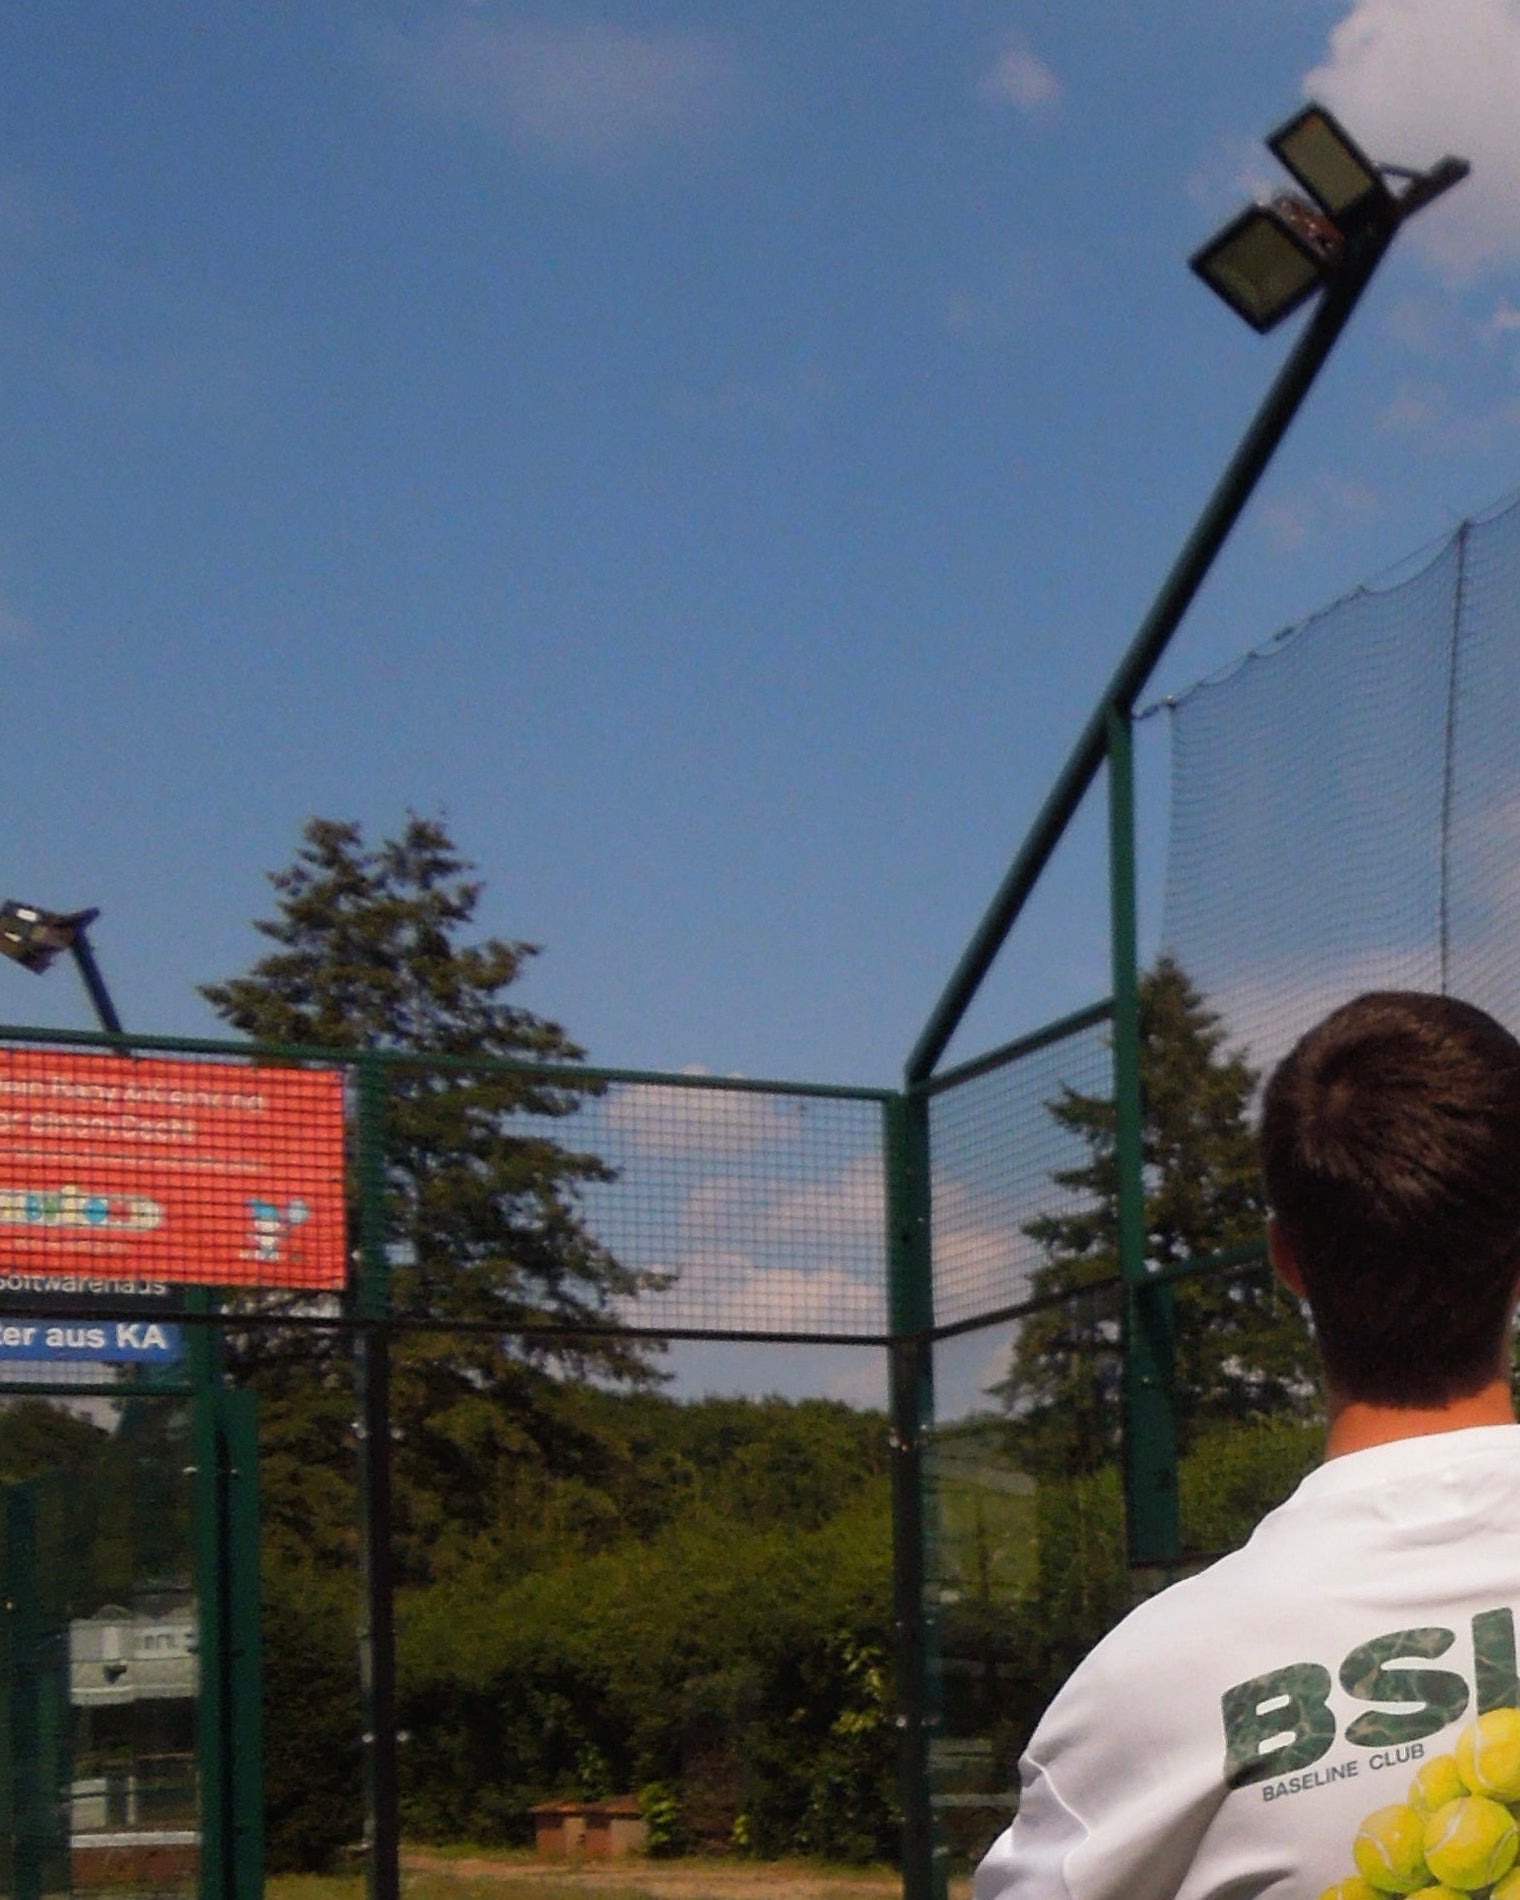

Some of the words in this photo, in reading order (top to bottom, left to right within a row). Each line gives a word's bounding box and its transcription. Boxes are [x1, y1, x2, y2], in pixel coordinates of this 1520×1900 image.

[0, 1326, 36, 1346] er
[46, 1328, 105, 1348] aus
[116, 1323, 168, 1349] KA
[1261, 1760, 1359, 1802] BASELINE
[1369, 1742, 1426, 1772] CLUB
